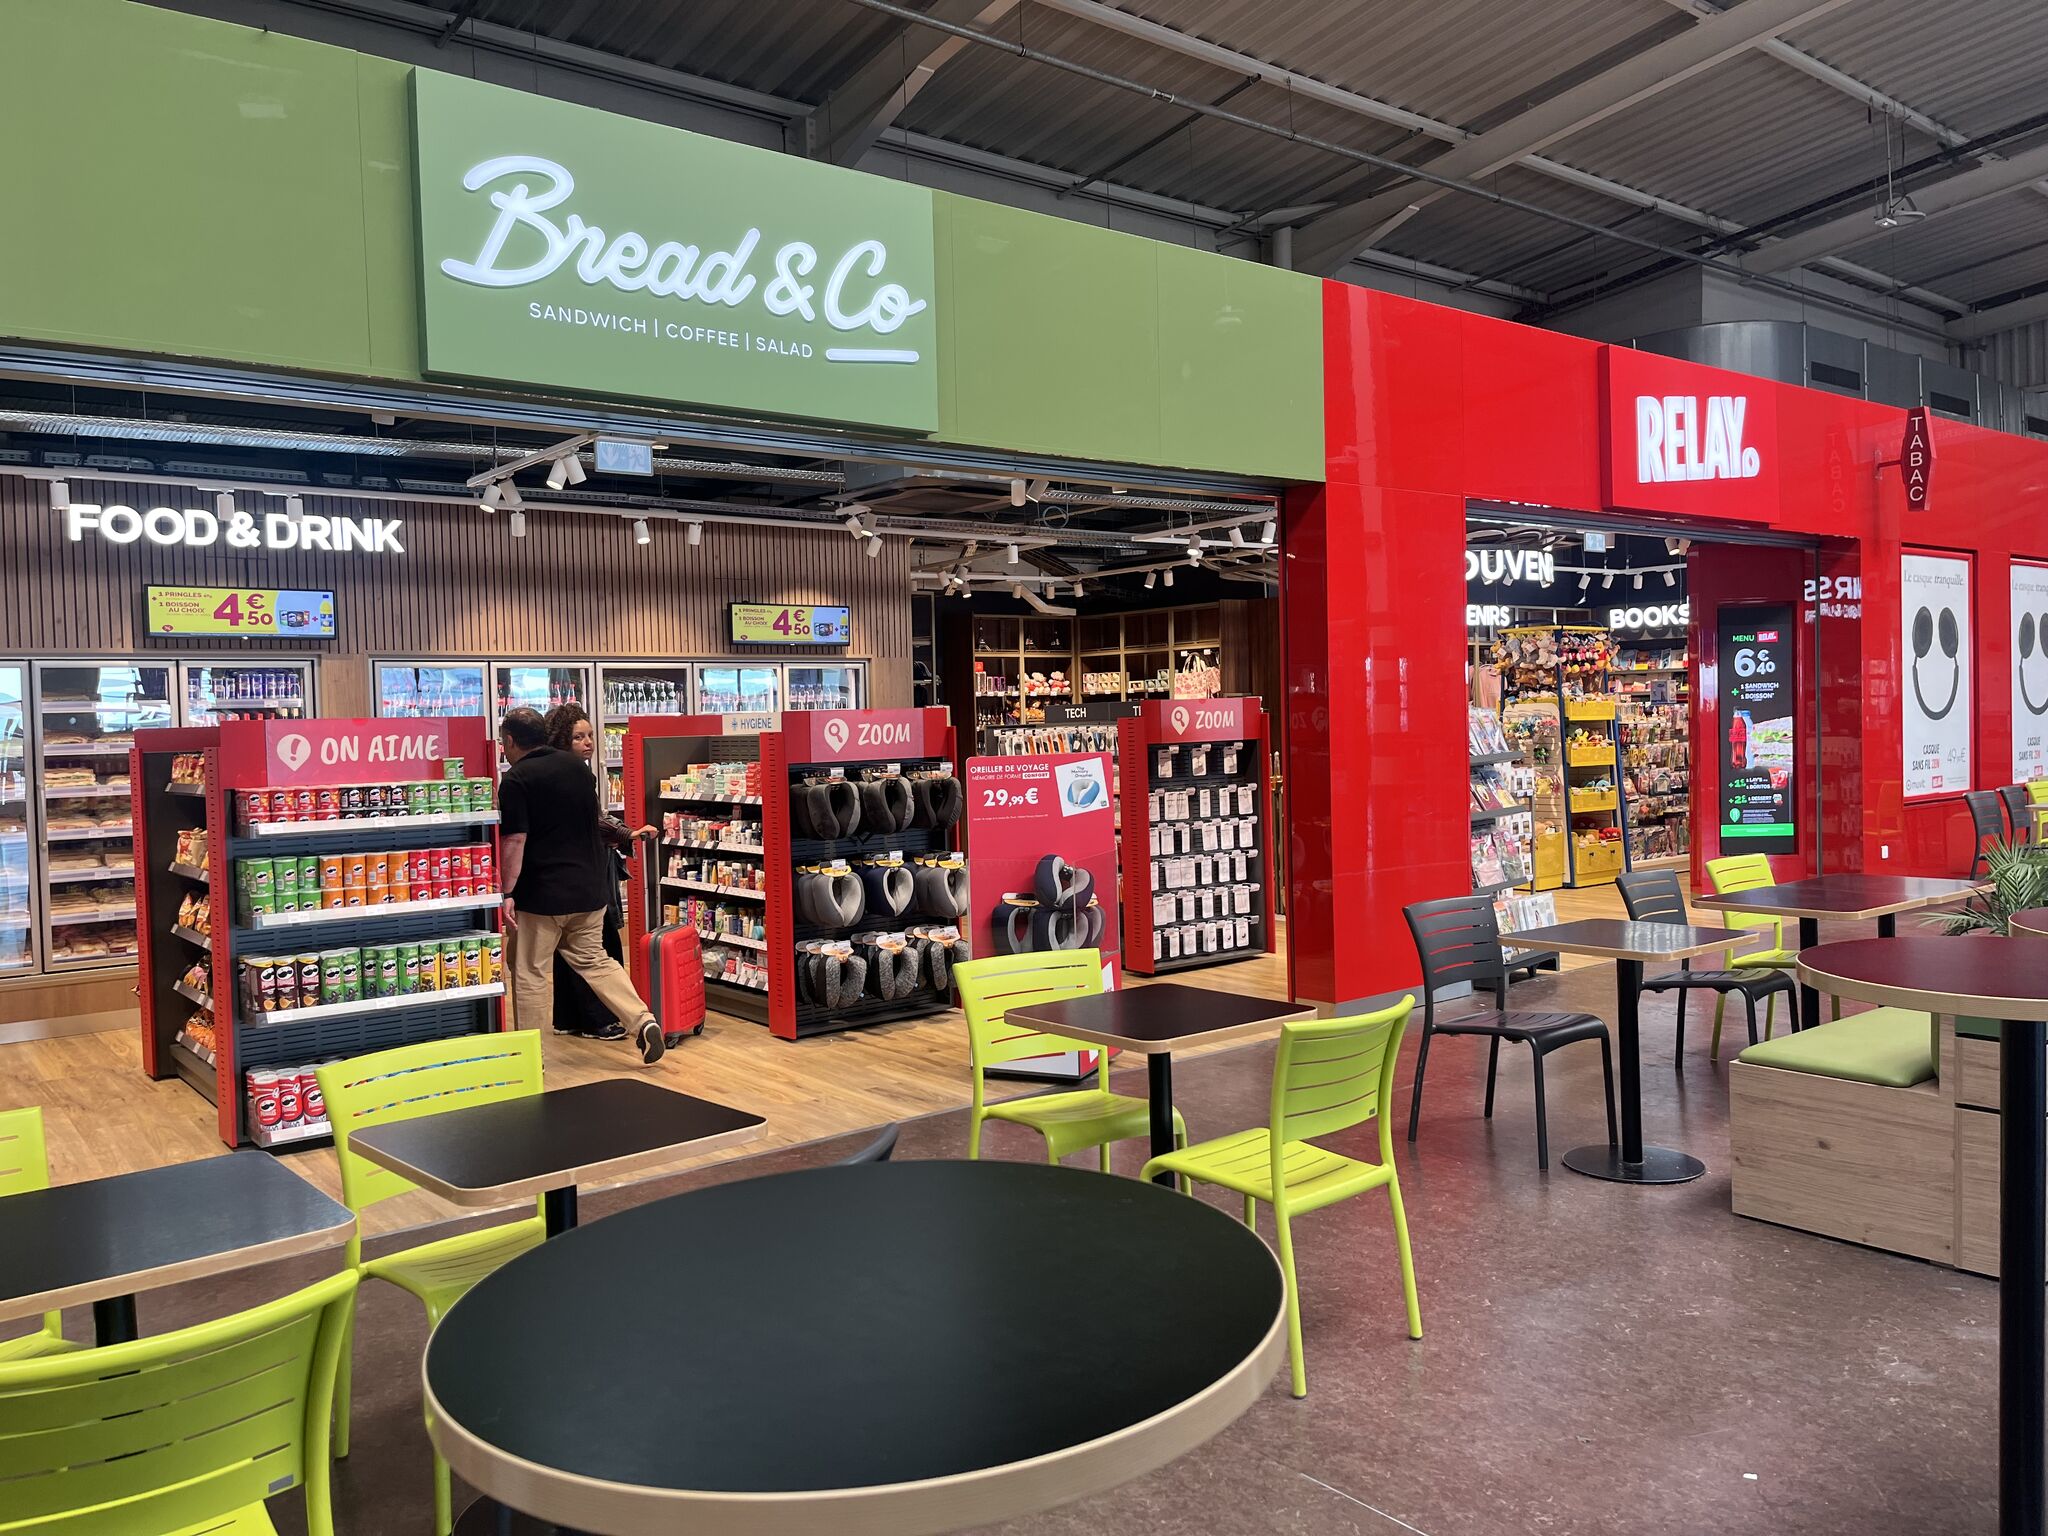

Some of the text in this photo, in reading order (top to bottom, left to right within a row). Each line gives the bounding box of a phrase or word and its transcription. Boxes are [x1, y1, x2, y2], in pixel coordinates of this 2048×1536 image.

[441, 155, 926, 334] Bread & Co
[529, 302, 813, 358] SANDWICH COFFEE SALAD
[1909, 417, 1924, 502] TABAC
[69, 504, 405, 553] FOOD & DRINK
[1610, 604, 1689, 628] BOOKS
[741, 718, 772, 730] HYGIENE
[1065, 707, 1087, 719] TECH
[1196, 710, 1234, 729] ZOOM
[858, 723, 910, 746] ZOOM
[321, 734, 440, 765] ON AIME
[970, 765, 1003, 774] OREILLER
[1017, 764, 1049, 772] VOYAGE
